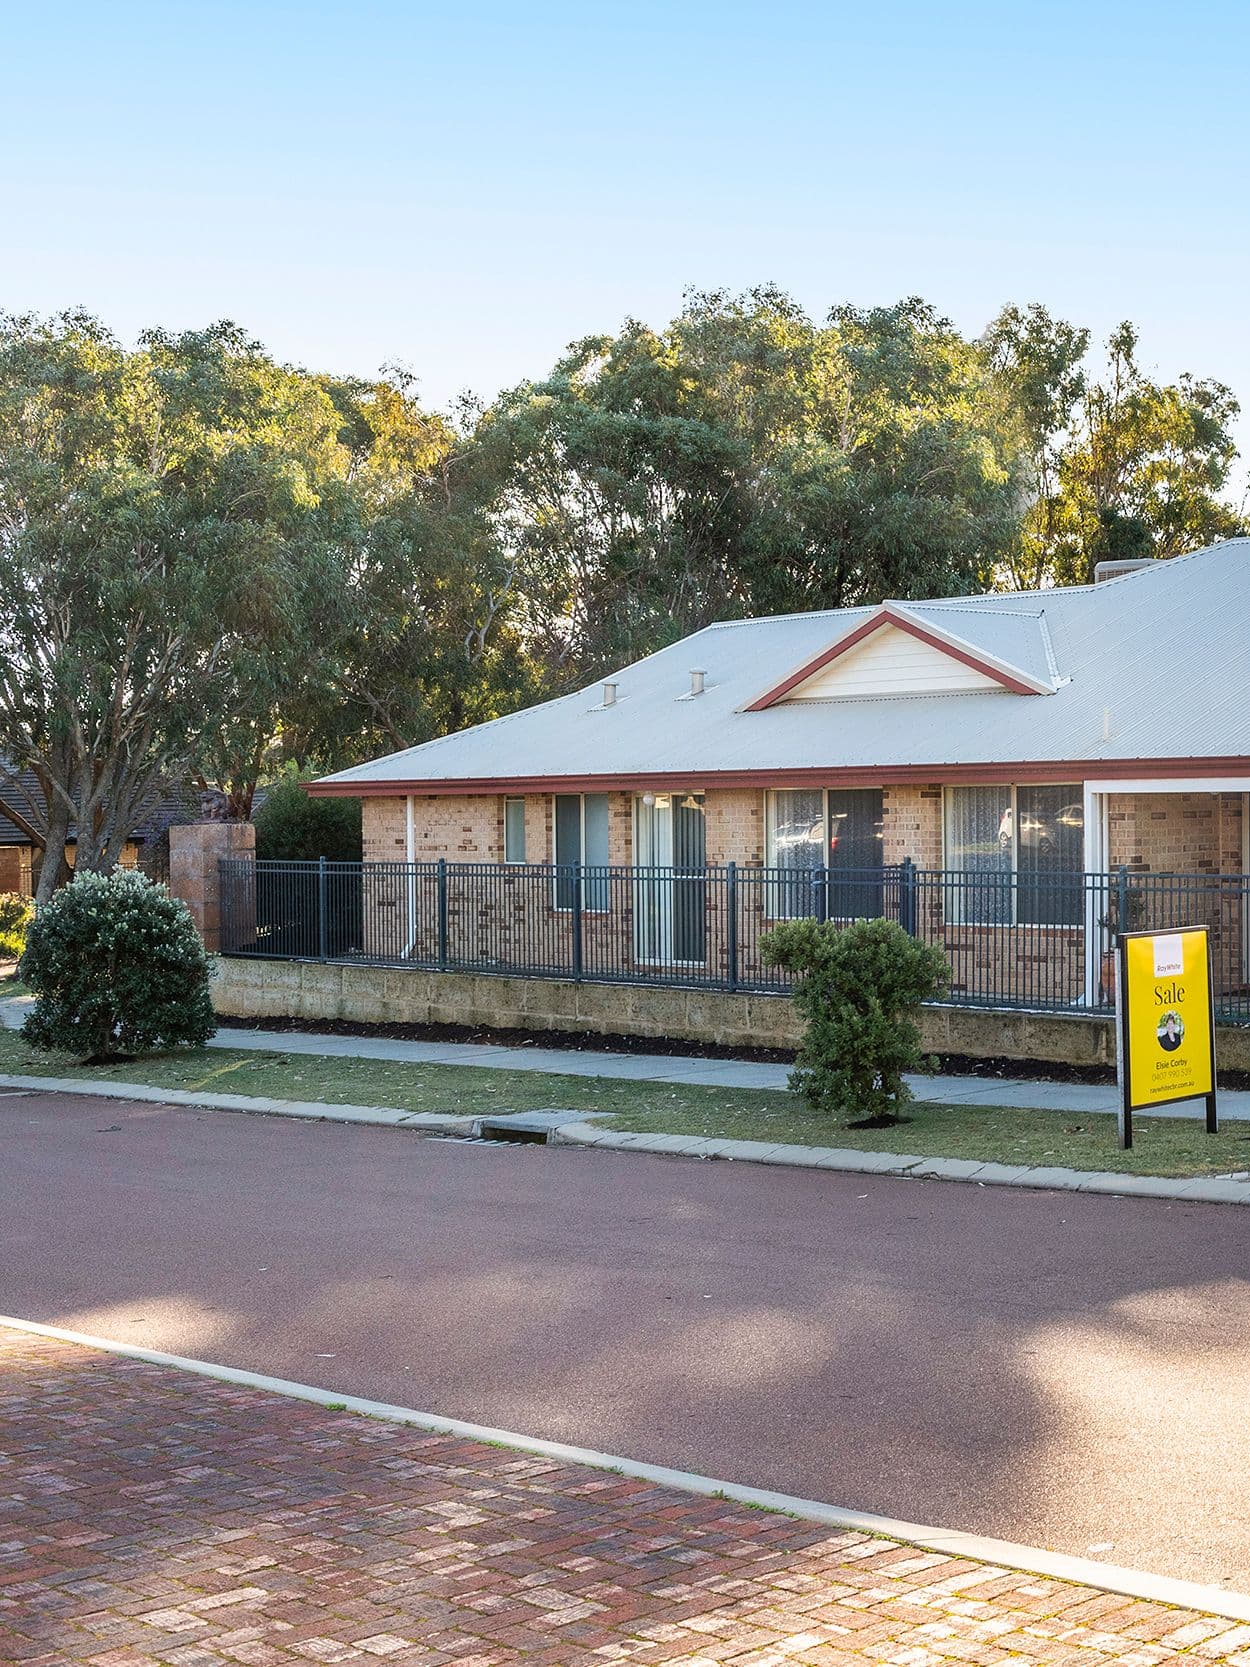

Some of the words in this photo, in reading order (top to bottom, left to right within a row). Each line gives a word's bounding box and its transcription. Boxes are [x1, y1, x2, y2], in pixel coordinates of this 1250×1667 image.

[1154, 982, 1185, 1006] Sale
[1156, 1061, 1169, 1070] Elsie
[1170, 1059, 1187, 1068] Corby
